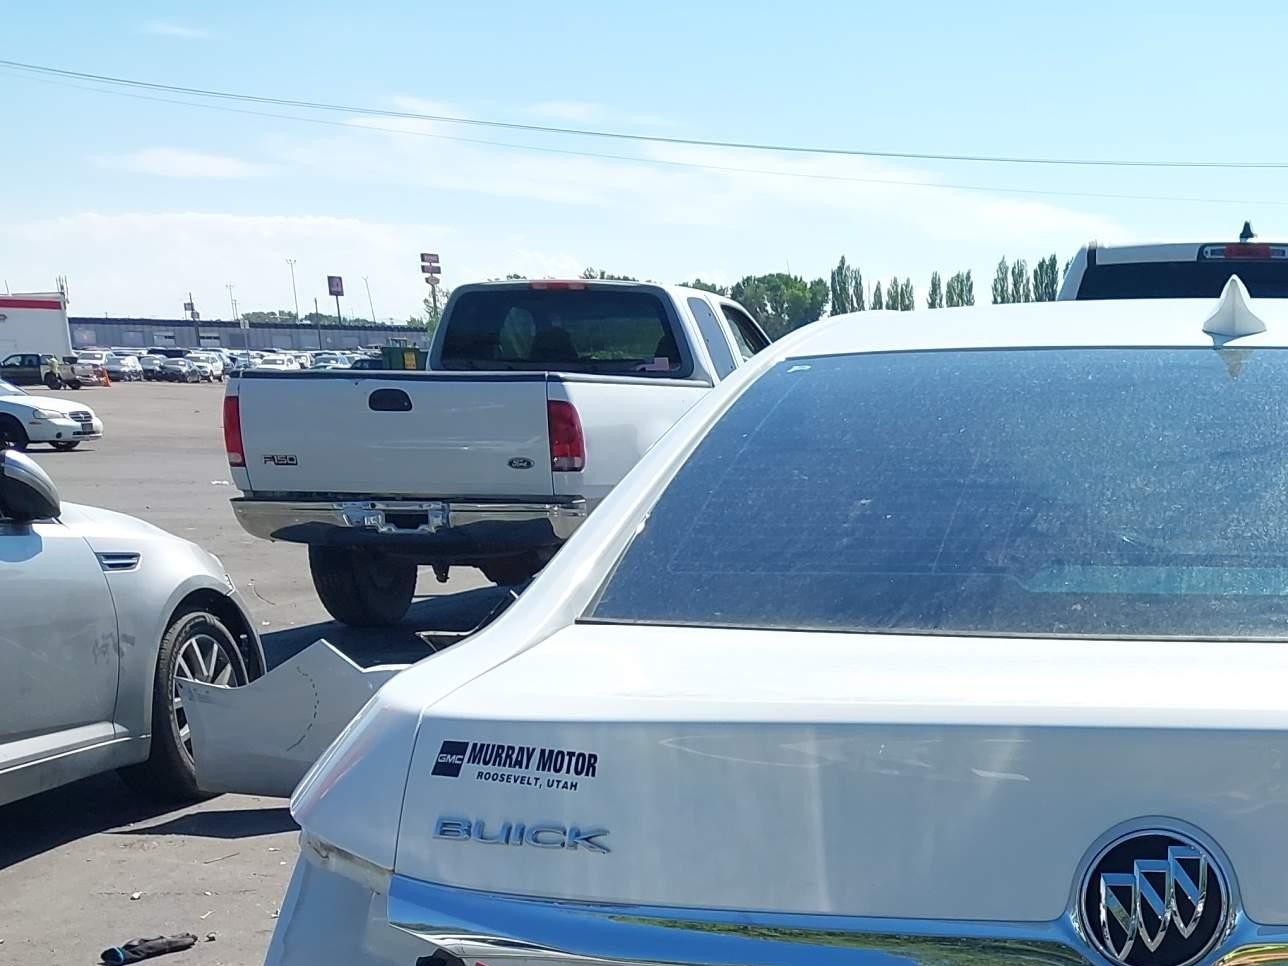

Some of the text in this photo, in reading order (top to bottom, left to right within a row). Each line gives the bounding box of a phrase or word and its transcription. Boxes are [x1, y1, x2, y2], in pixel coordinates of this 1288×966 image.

[437, 754, 464, 764] GMC
[467, 742, 598, 778] MURRAY MOTOR
[476, 771, 579, 791] ROOSEVELT, UTAH
[432, 815, 612, 855] BUICK
